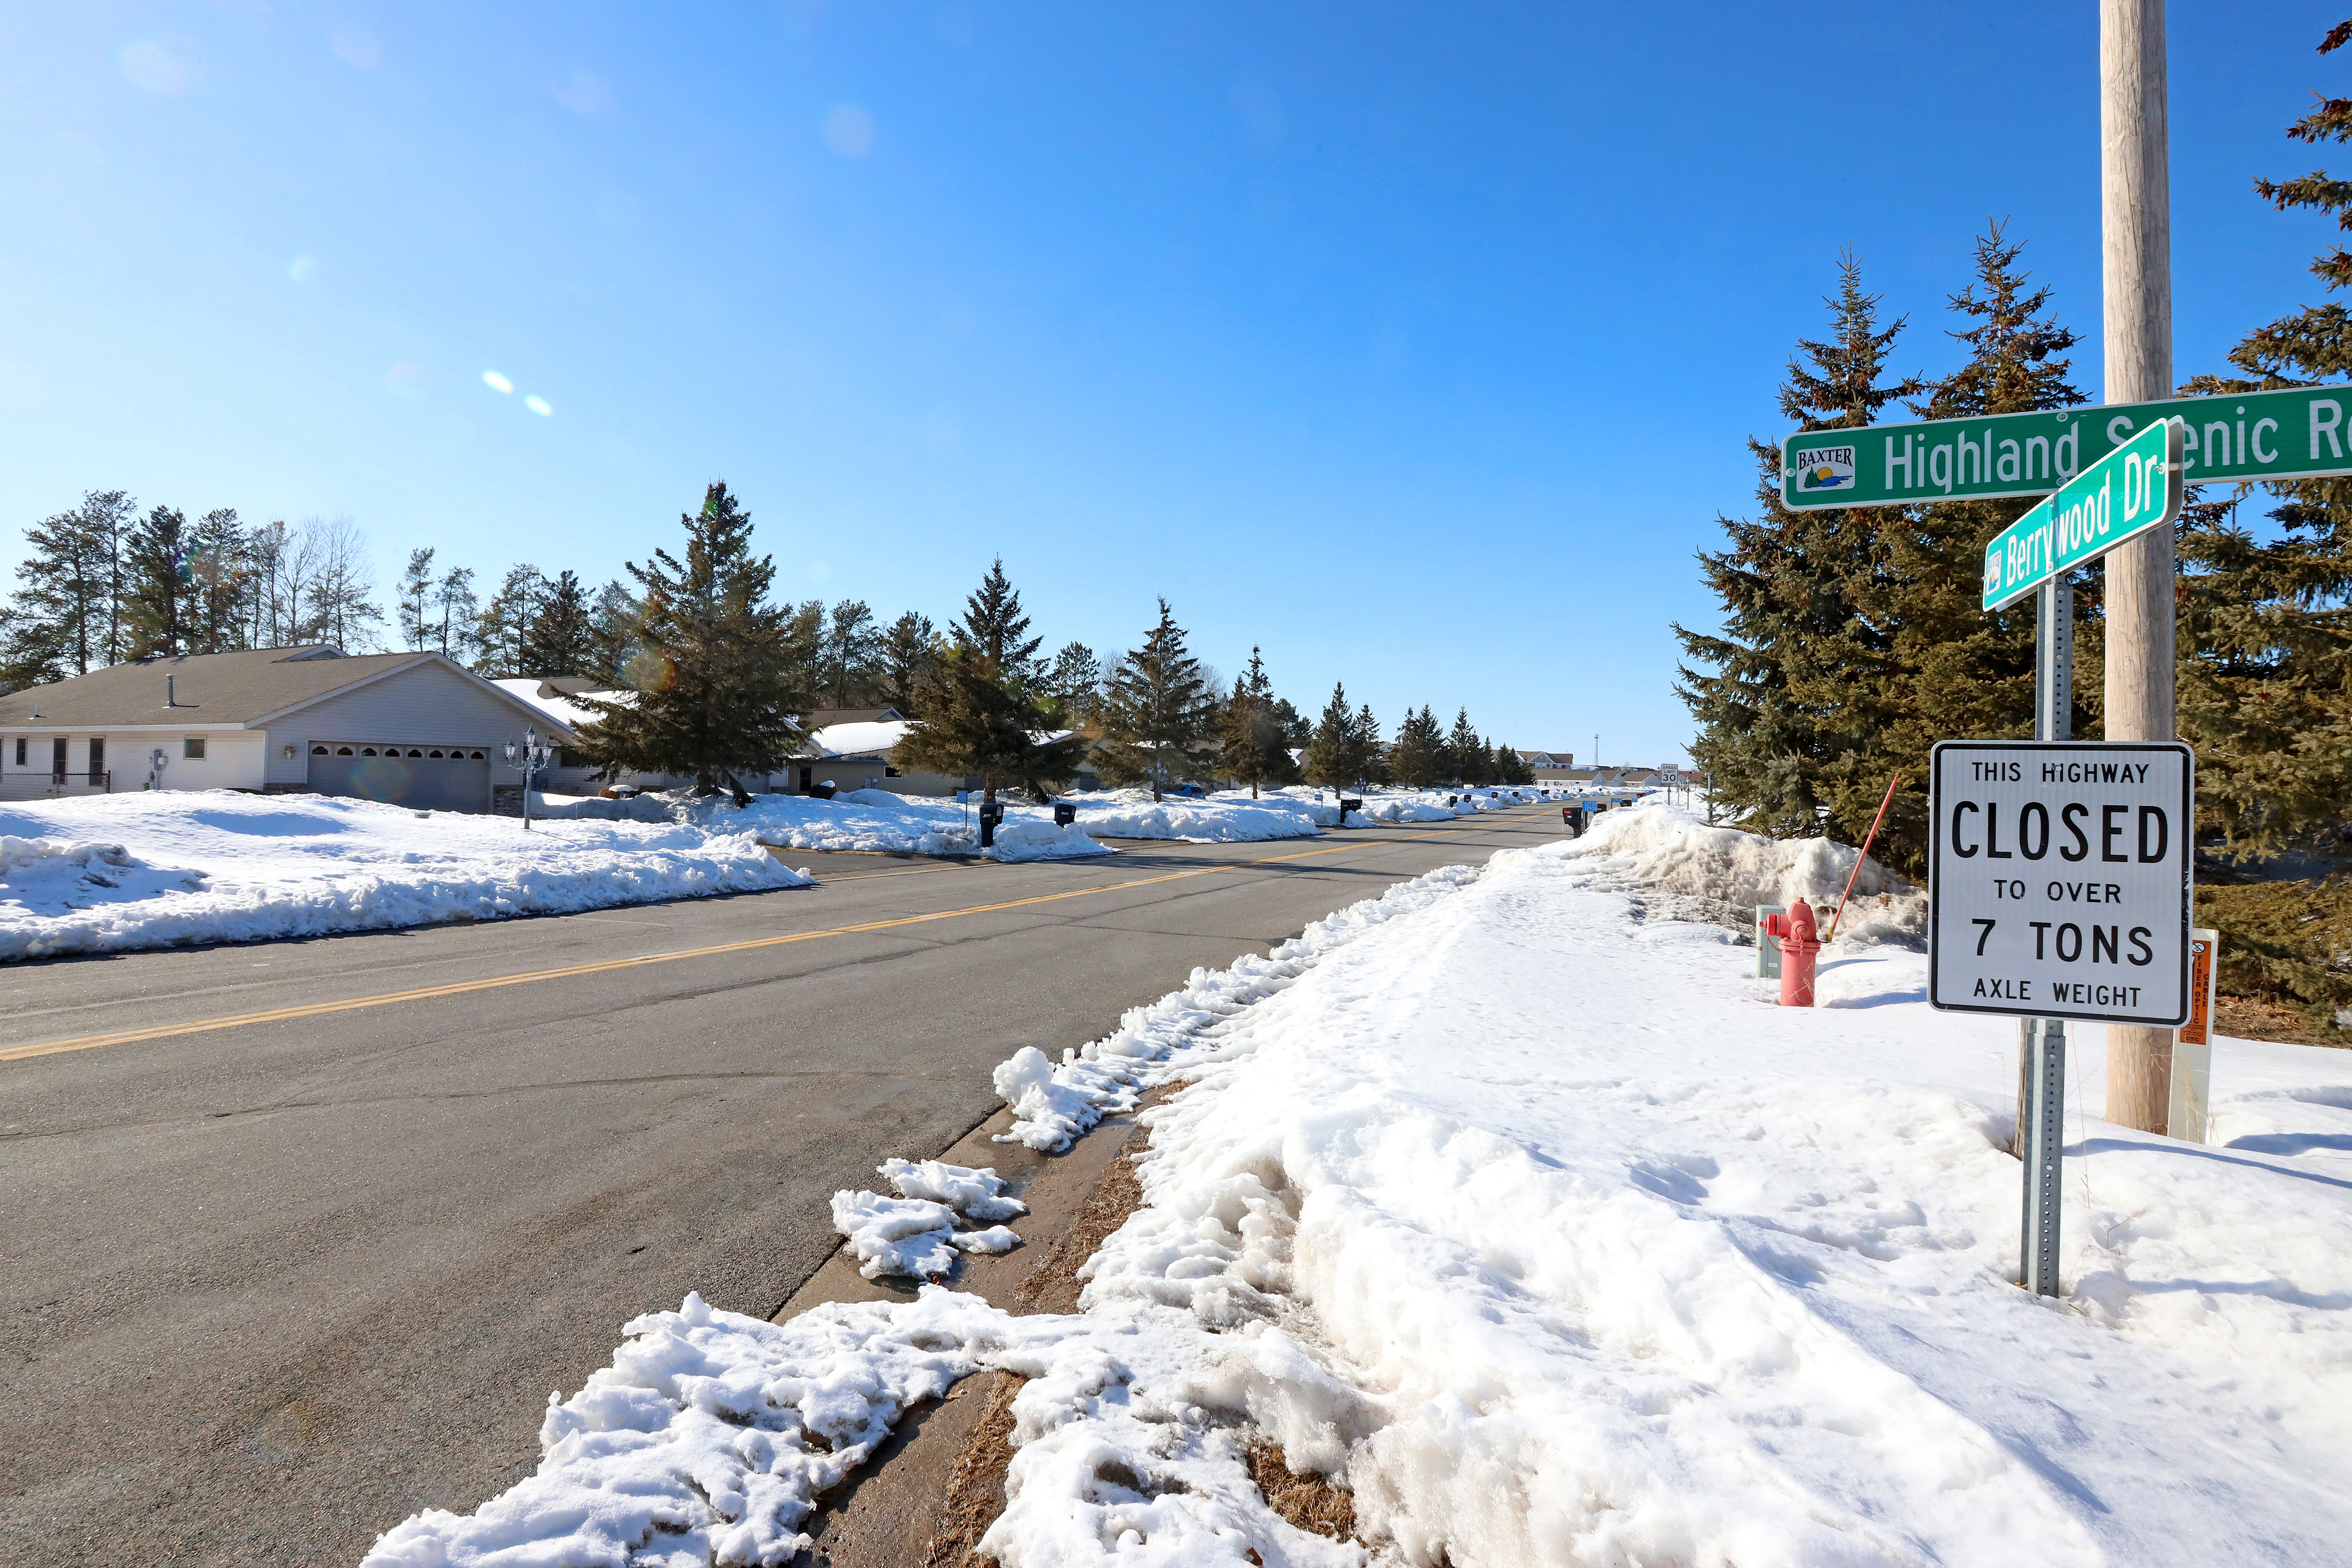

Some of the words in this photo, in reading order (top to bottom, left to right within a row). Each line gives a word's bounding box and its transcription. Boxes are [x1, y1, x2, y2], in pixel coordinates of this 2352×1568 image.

[1798, 448, 1853, 471] BAXTER
[1885, 420, 2079, 494] Highland
[2107, 406, 2279, 470] Senic
[2310, 399, 2352, 459] R
[2006, 468, 2111, 588] Berrywood
[2124, 452, 2158, 523] Dr
[1972, 762, 2021, 782] THIS
[2042, 763, 2149, 784] HIGHWAY
[1952, 801, 2168, 863] CLOSED
[1994, 880, 2025, 900] TO
[2047, 881, 2121, 904] OVER
[1972, 919, 1995, 956] 7
[2029, 922, 2153, 966] TONS
[1974, 978, 2031, 1001] AXLE
[2053, 982, 2141, 1007] WEIGHT
